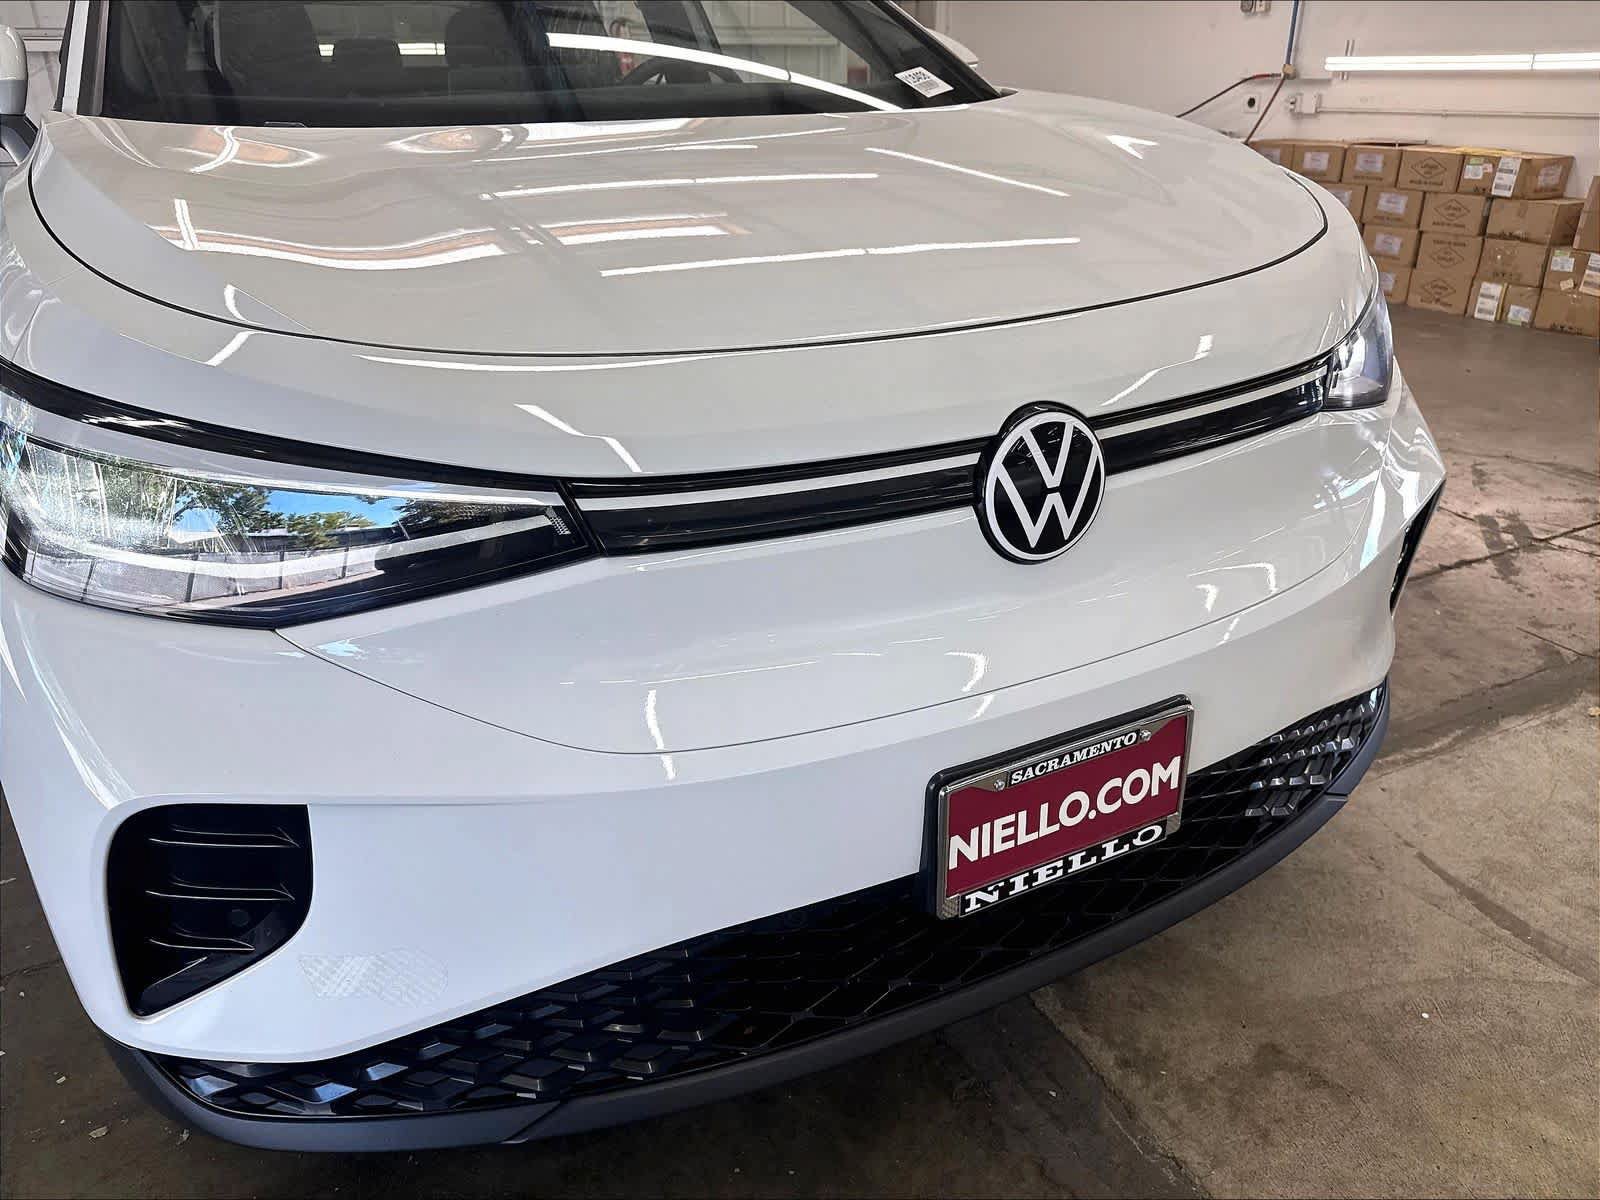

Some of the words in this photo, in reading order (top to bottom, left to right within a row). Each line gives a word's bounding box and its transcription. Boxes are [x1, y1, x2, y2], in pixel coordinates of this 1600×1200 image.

[995, 421, 1099, 549] VW
[1011, 732, 1138, 784] SACRAMENTO
[949, 756, 1181, 869] NIELLO.COM
[965, 825, 1163, 912] NIELLO
